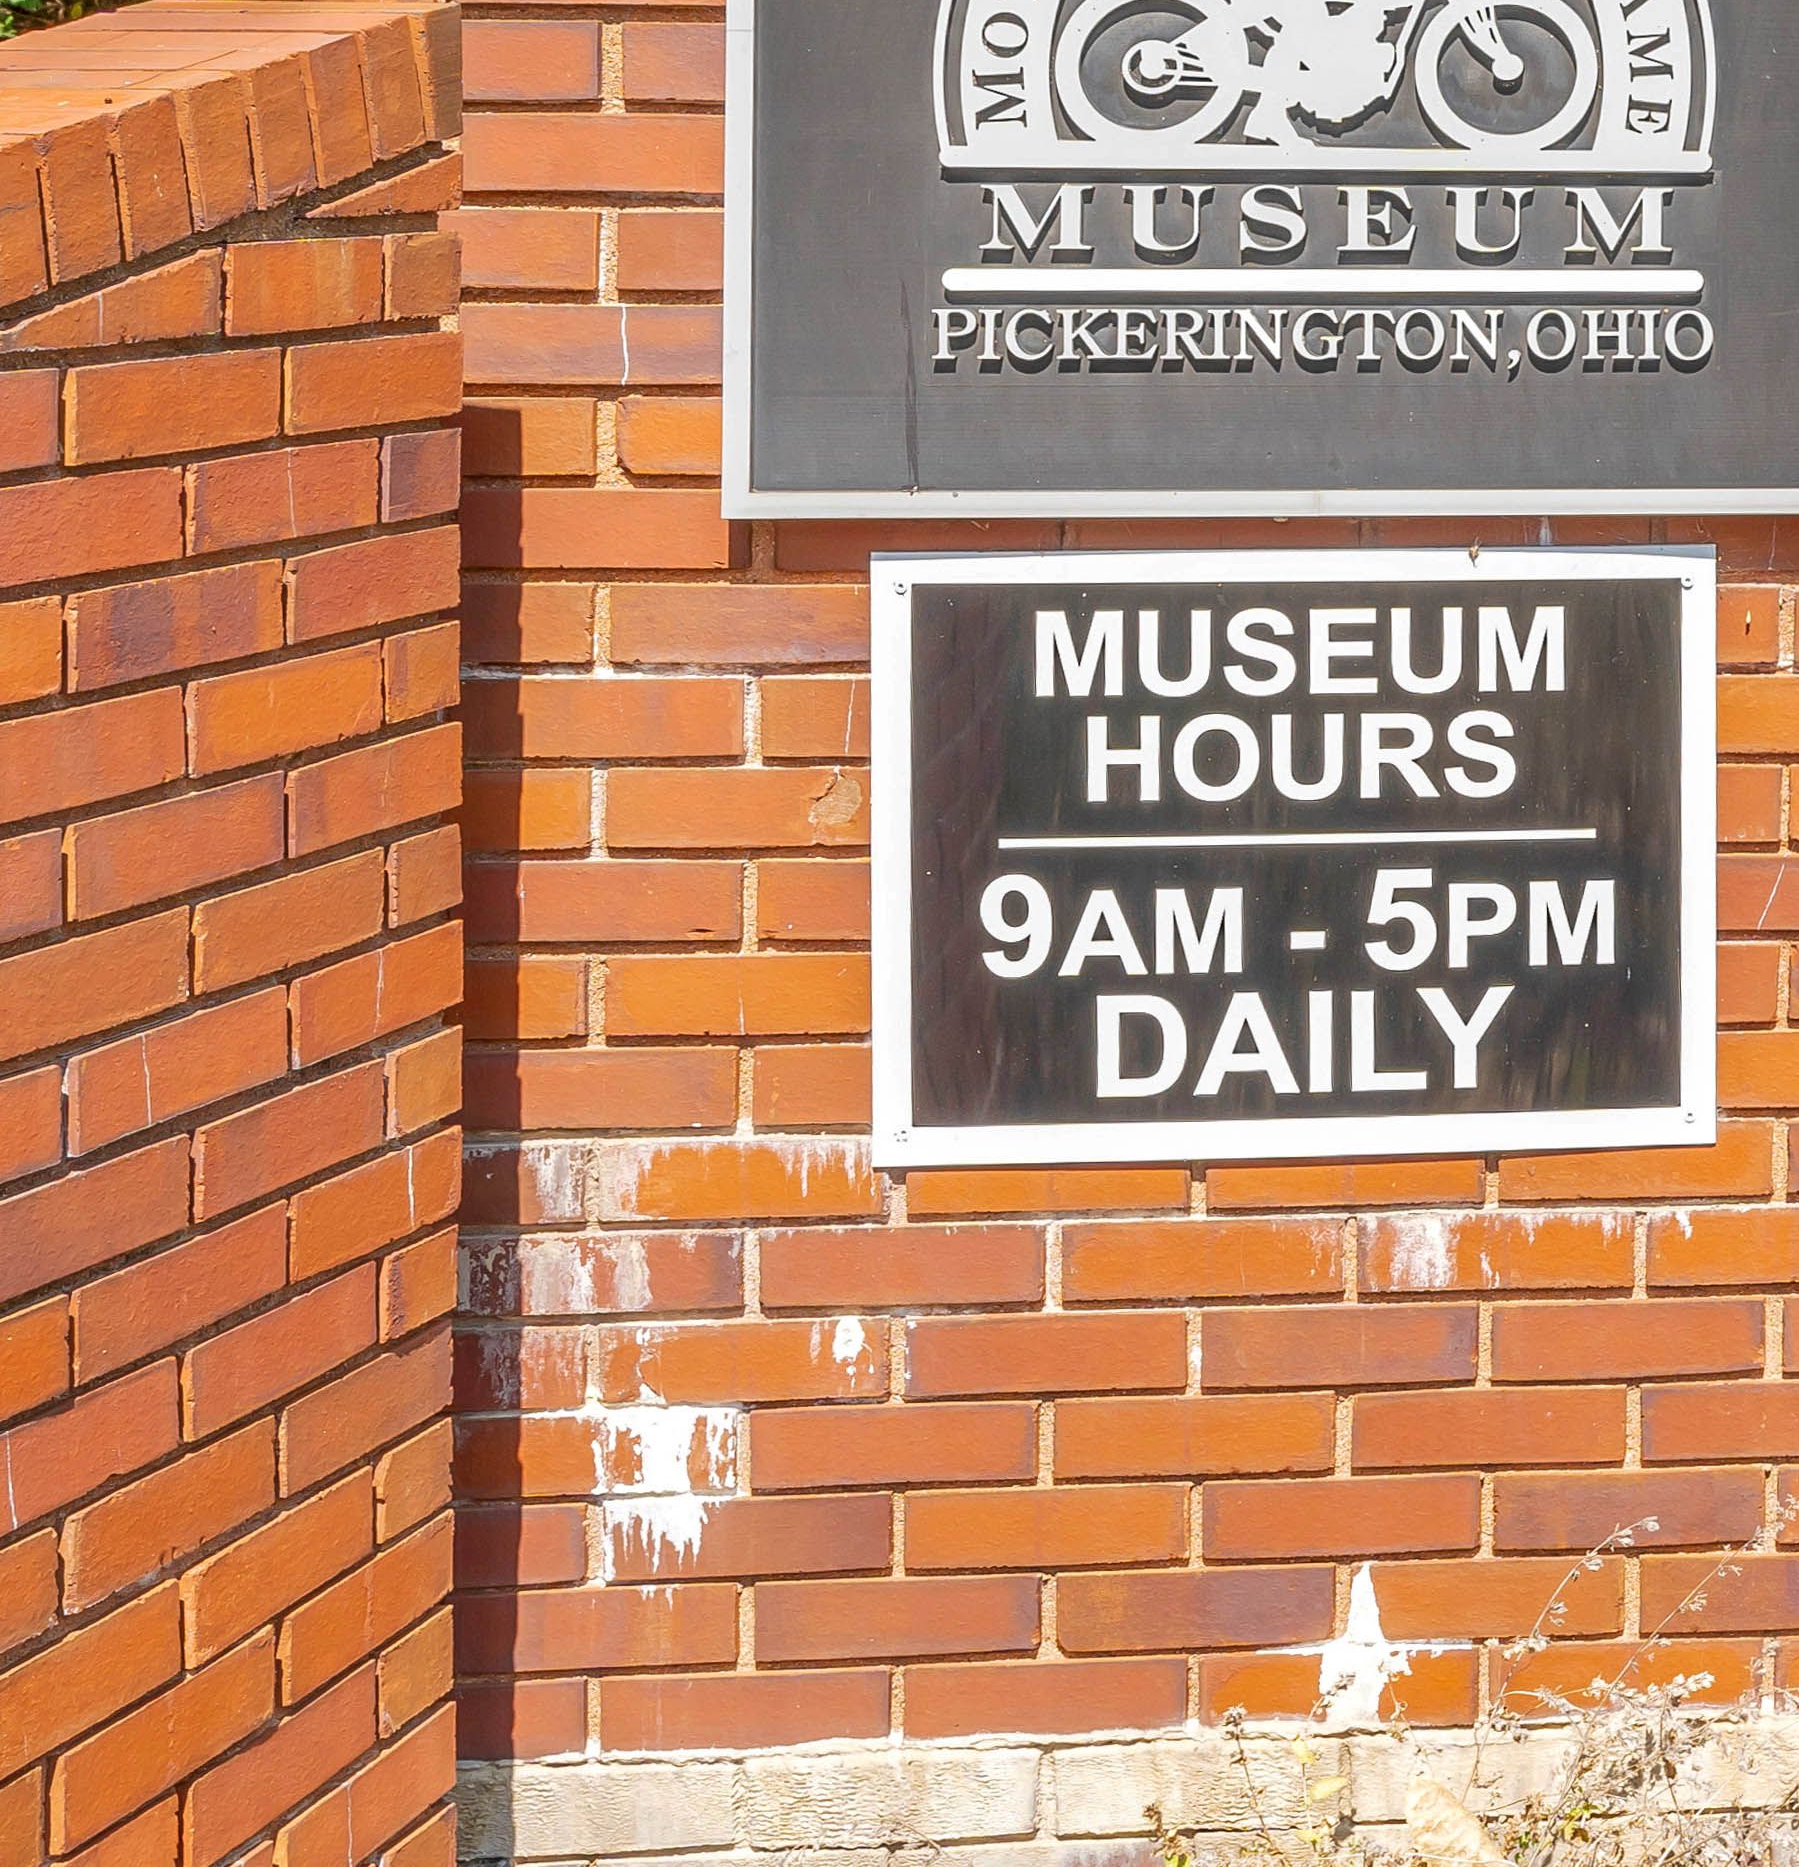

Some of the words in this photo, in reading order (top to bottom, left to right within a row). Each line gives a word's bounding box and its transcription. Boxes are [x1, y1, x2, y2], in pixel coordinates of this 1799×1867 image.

[978, 183, 1676, 253] MUSEUM
[1033, 605, 1567, 698] MUSEUM
[1085, 709, 1517, 803] HOURS
[979, 873, 1244, 979] 9AM
[1289, 929, 1327, 951] -
[1364, 867, 1616, 973] 5PM
[1095, 985, 1516, 1099] DAILY
